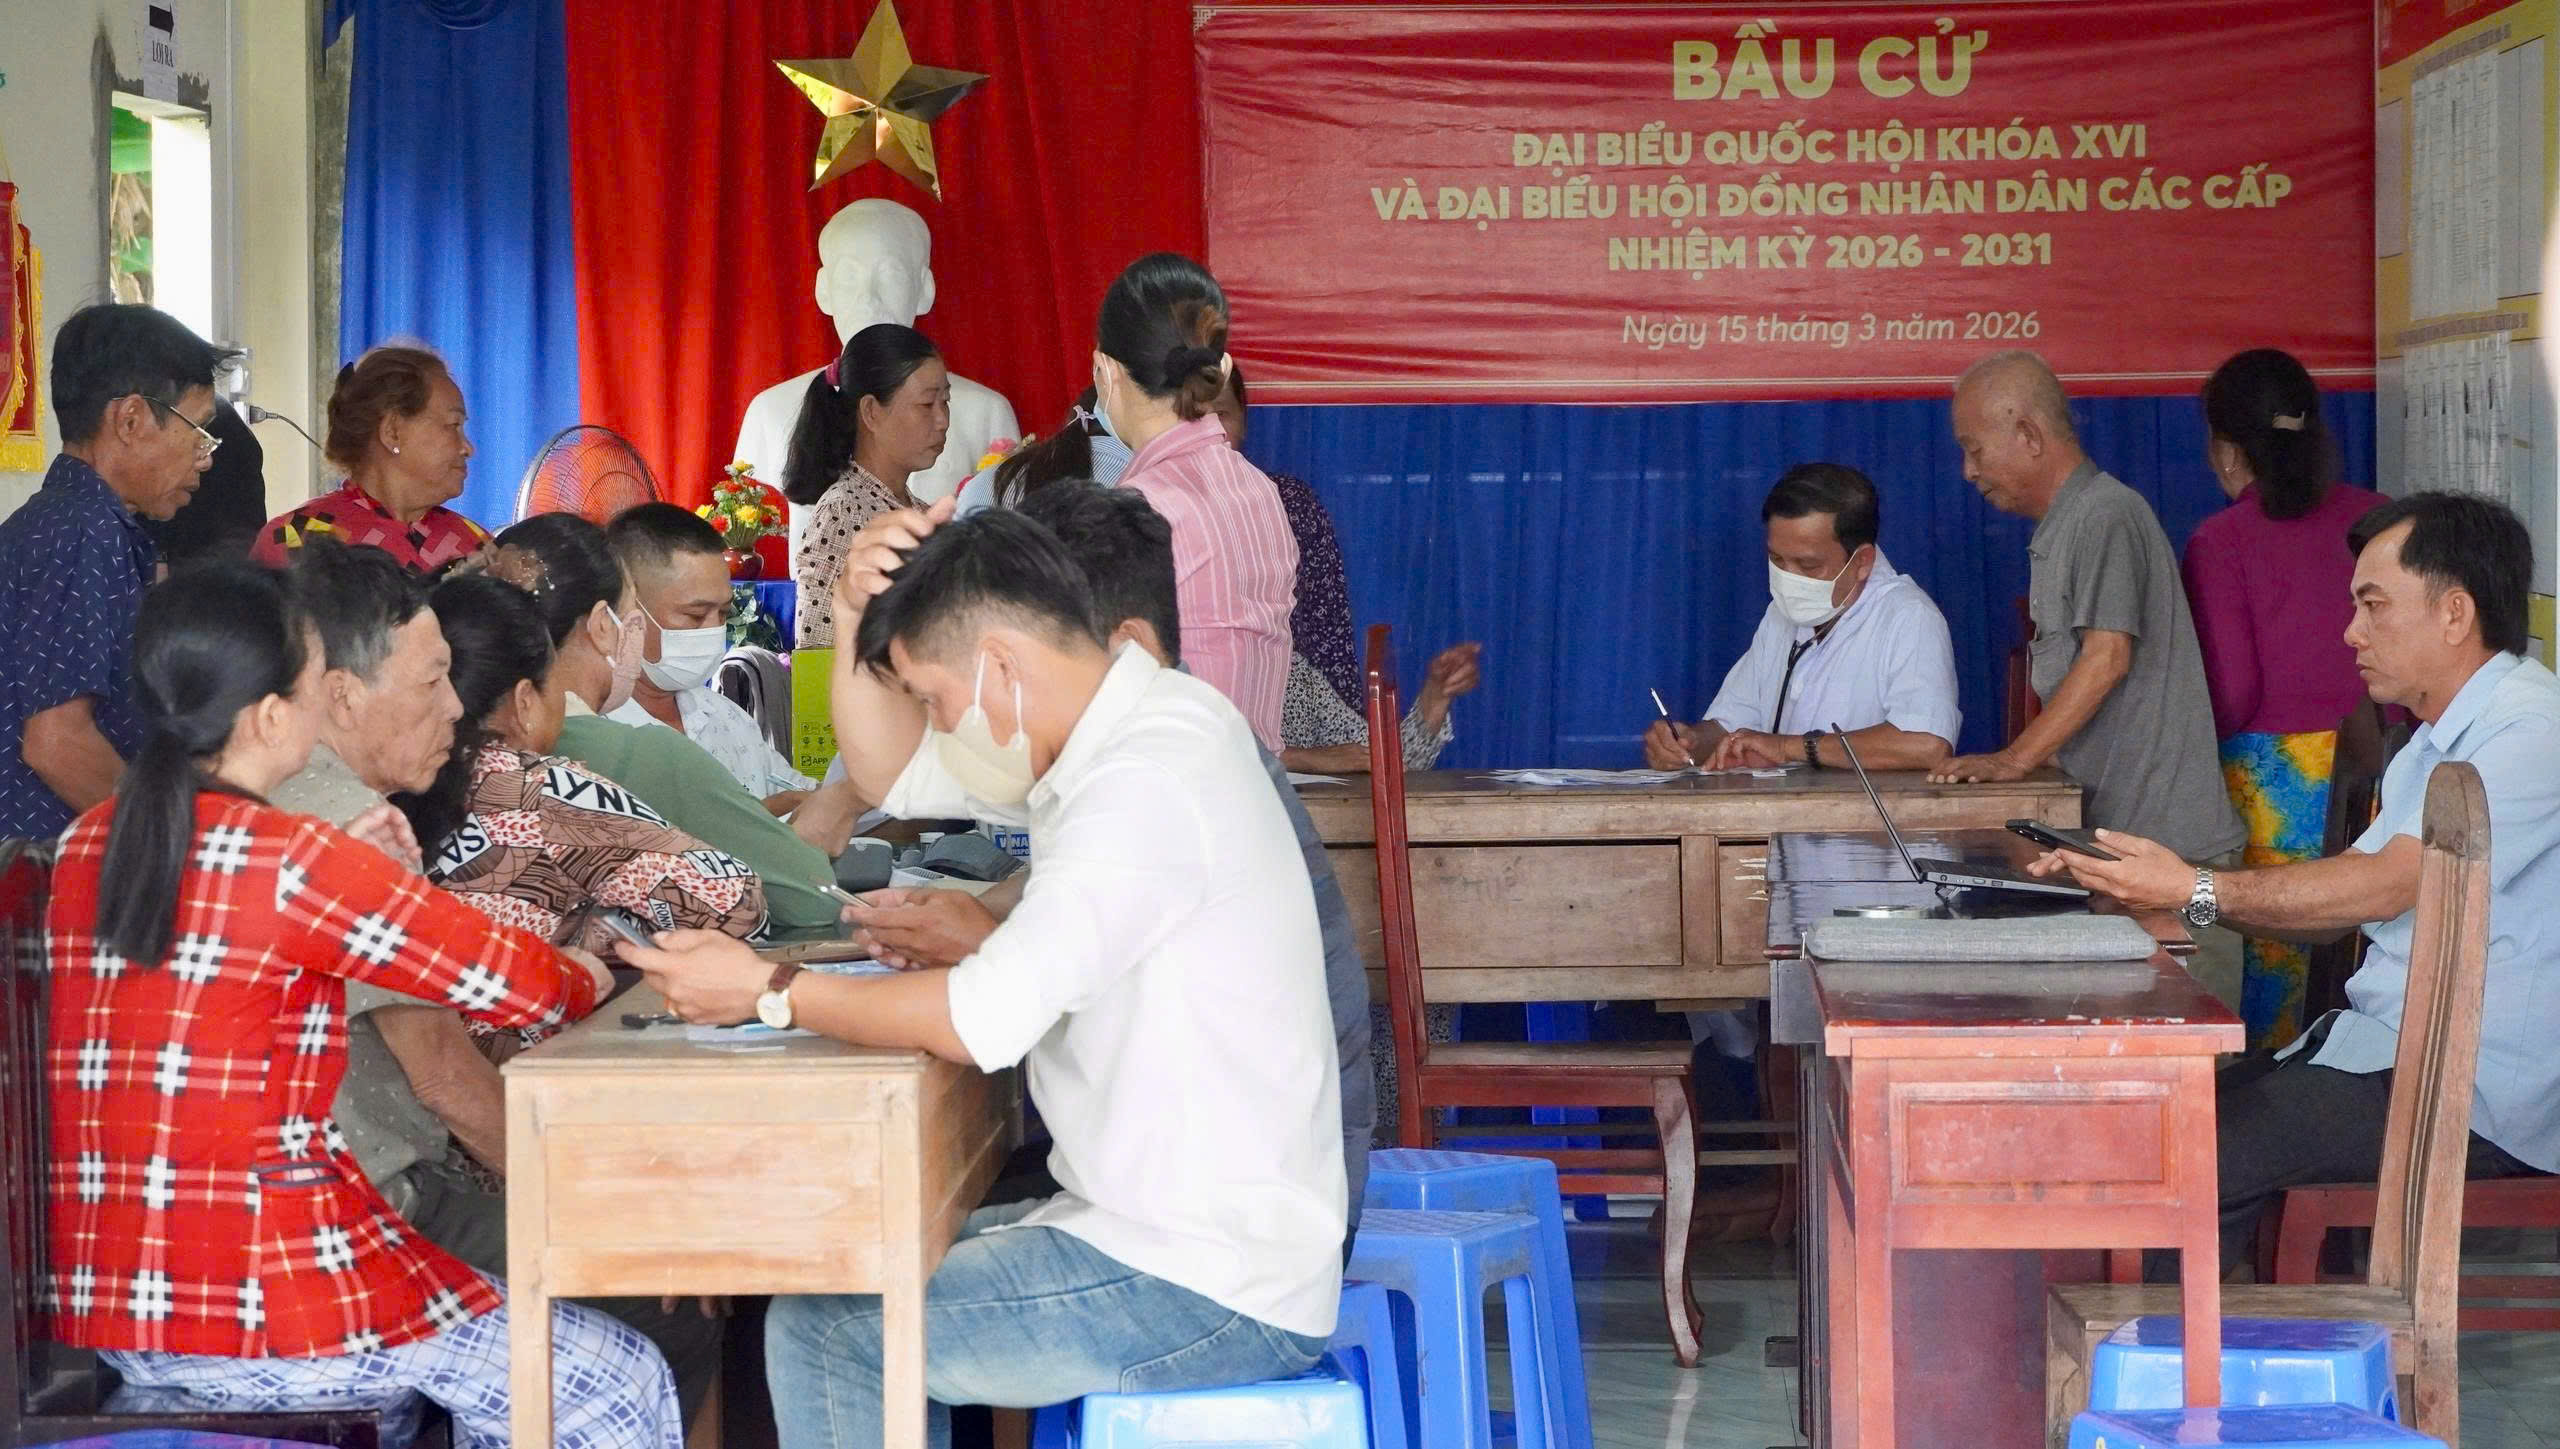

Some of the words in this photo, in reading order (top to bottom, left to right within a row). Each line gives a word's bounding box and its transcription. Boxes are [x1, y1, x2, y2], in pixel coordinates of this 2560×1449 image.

[1673, 19, 1835, 100] BẦU
[1858, 18, 1989, 98] CỬ
[1512, 132, 1585, 177] ĐẠI
[1597, 120, 1693, 166] BIỂU
[1703, 119, 1836, 166] QUỐC
[1847, 119, 1925, 174] HỘI
[1937, 117, 2062, 161] KHÓA
[2071, 124, 2147, 159] XVI
[1371, 178, 1428, 221] VÀ
[1437, 185, 1510, 231] ĐẠI
[1522, 174, 1618, 220] BIỂU
[1629, 174, 1708, 229] HỘI
[1718, 171, 1849, 217] ĐỒNG
[1860, 171, 1985, 215] NHÂN
[1996, 169, 2088, 213] DÂN
[2098, 167, 2193, 211] CÁC
[2202, 162, 2293, 208] CẤP
[1608, 226, 1747, 281] NHIỆM
[1758, 225, 1817, 269] KỲ
[1825, 233, 1924, 269] 2026
[1934, 247, 1951, 257] -
[1960, 232, 2052, 267] 2031
[1622, 315, 1708, 350] Ngày
[1717, 315, 1748, 343] 15
[1756, 311, 1850, 348] tháng
[1859, 313, 1877, 341] 3
[1885, 312, 1955, 341] năm
[1963, 311, 2041, 340] 2026
